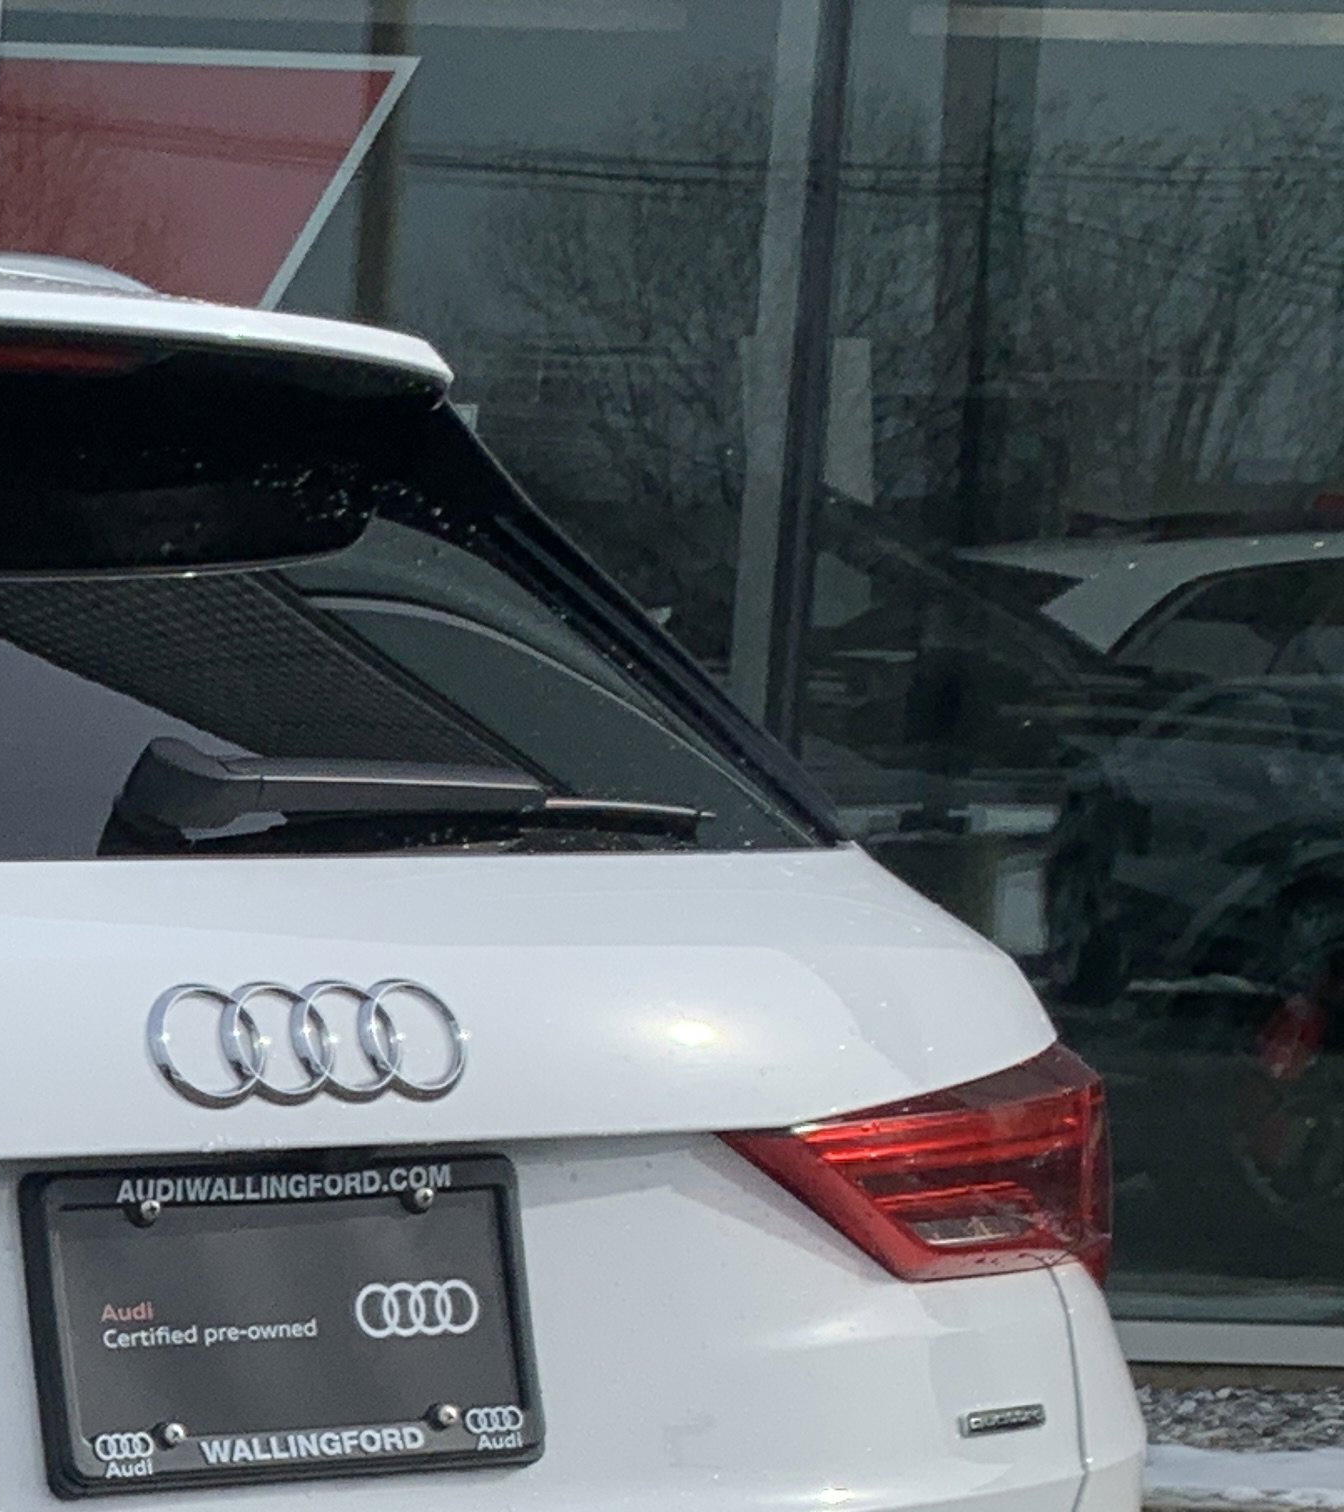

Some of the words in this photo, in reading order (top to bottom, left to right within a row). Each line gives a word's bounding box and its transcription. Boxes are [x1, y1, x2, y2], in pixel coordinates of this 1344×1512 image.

[117, 1165, 452, 1204] AUDIWALLINGFORD.COM
[101, 1301, 154, 1322] Audi
[102, 1326, 198, 1350] Certified
[204, 1319, 318, 1346] pre-owned
[200, 1427, 425, 1464] WALLINGFORD
[477, 1431, 523, 1450] Audi
[105, 1459, 154, 1479] Audi
